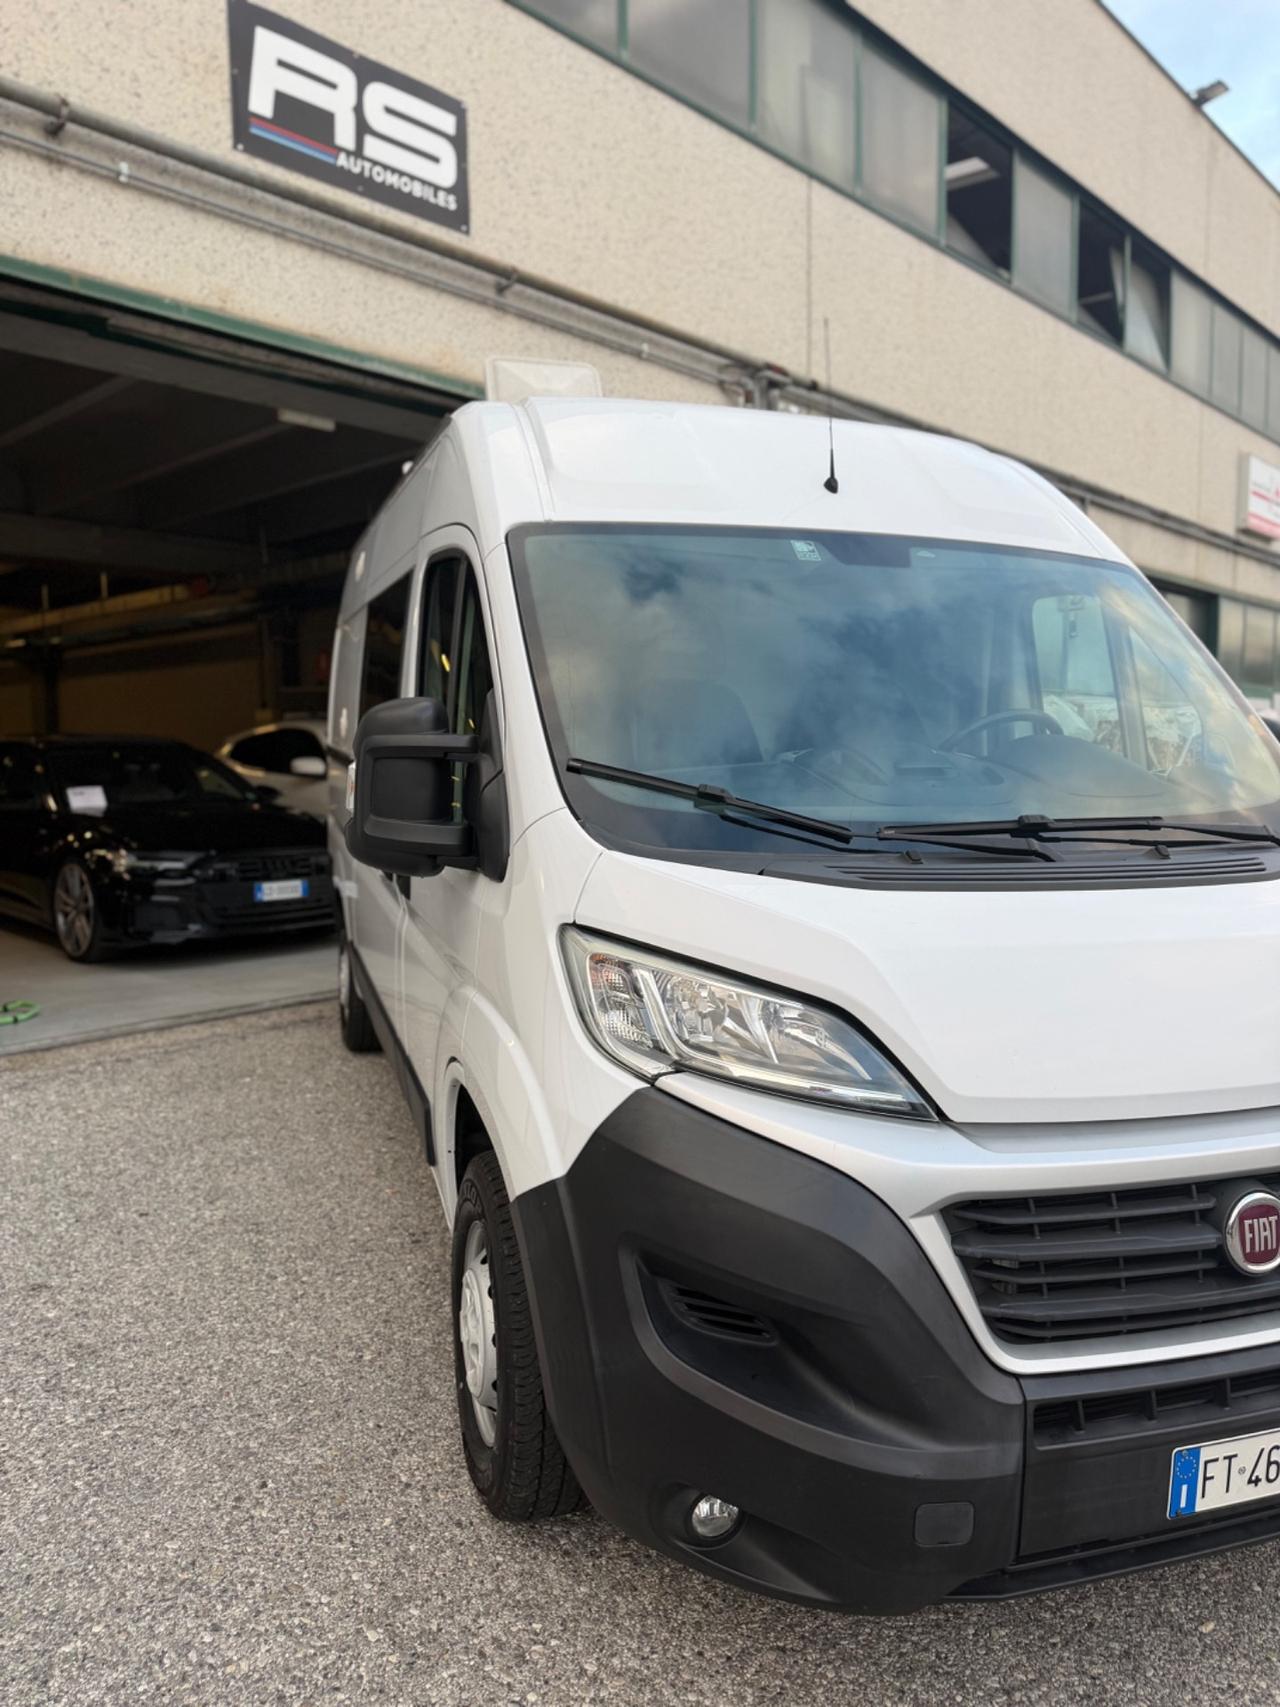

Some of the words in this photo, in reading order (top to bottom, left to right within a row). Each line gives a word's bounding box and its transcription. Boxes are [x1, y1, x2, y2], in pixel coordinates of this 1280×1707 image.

[248, 25, 457, 189] RS
[336, 151, 457, 211] AUTOMOBILES
[1243, 1215, 1278, 1253] FIAT
